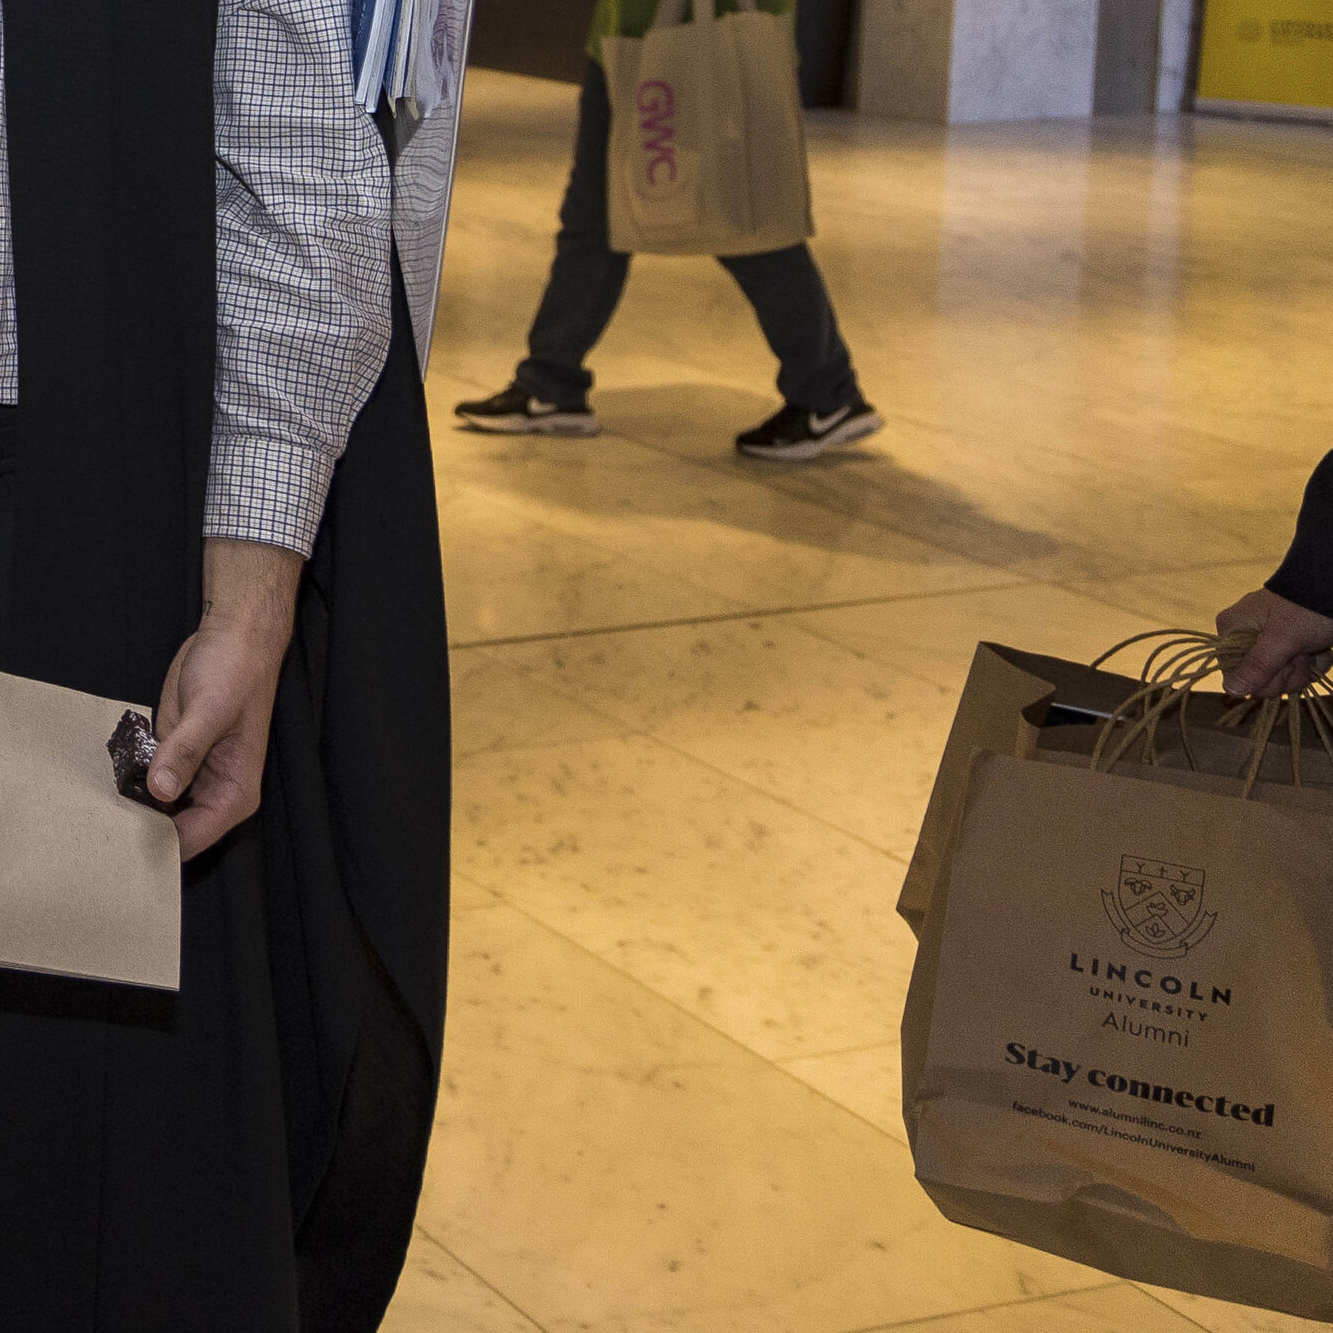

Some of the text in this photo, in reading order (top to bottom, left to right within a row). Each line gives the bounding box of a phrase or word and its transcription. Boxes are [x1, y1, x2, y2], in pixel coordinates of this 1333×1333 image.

[636, 80, 677, 186] GWC
[1070, 953, 1232, 1006] LINCOLN
[1090, 986, 1208, 1022] UNIVERSITY
[1101, 1011, 1190, 1047] Alumni
[1005, 1042, 1275, 1127] Stay connected
[1012, 1100, 1256, 1172] facebook.com/LincolnUniversityAlumni
[1067, 1098, 1202, 1140] www.alumnilinc.co.nz
